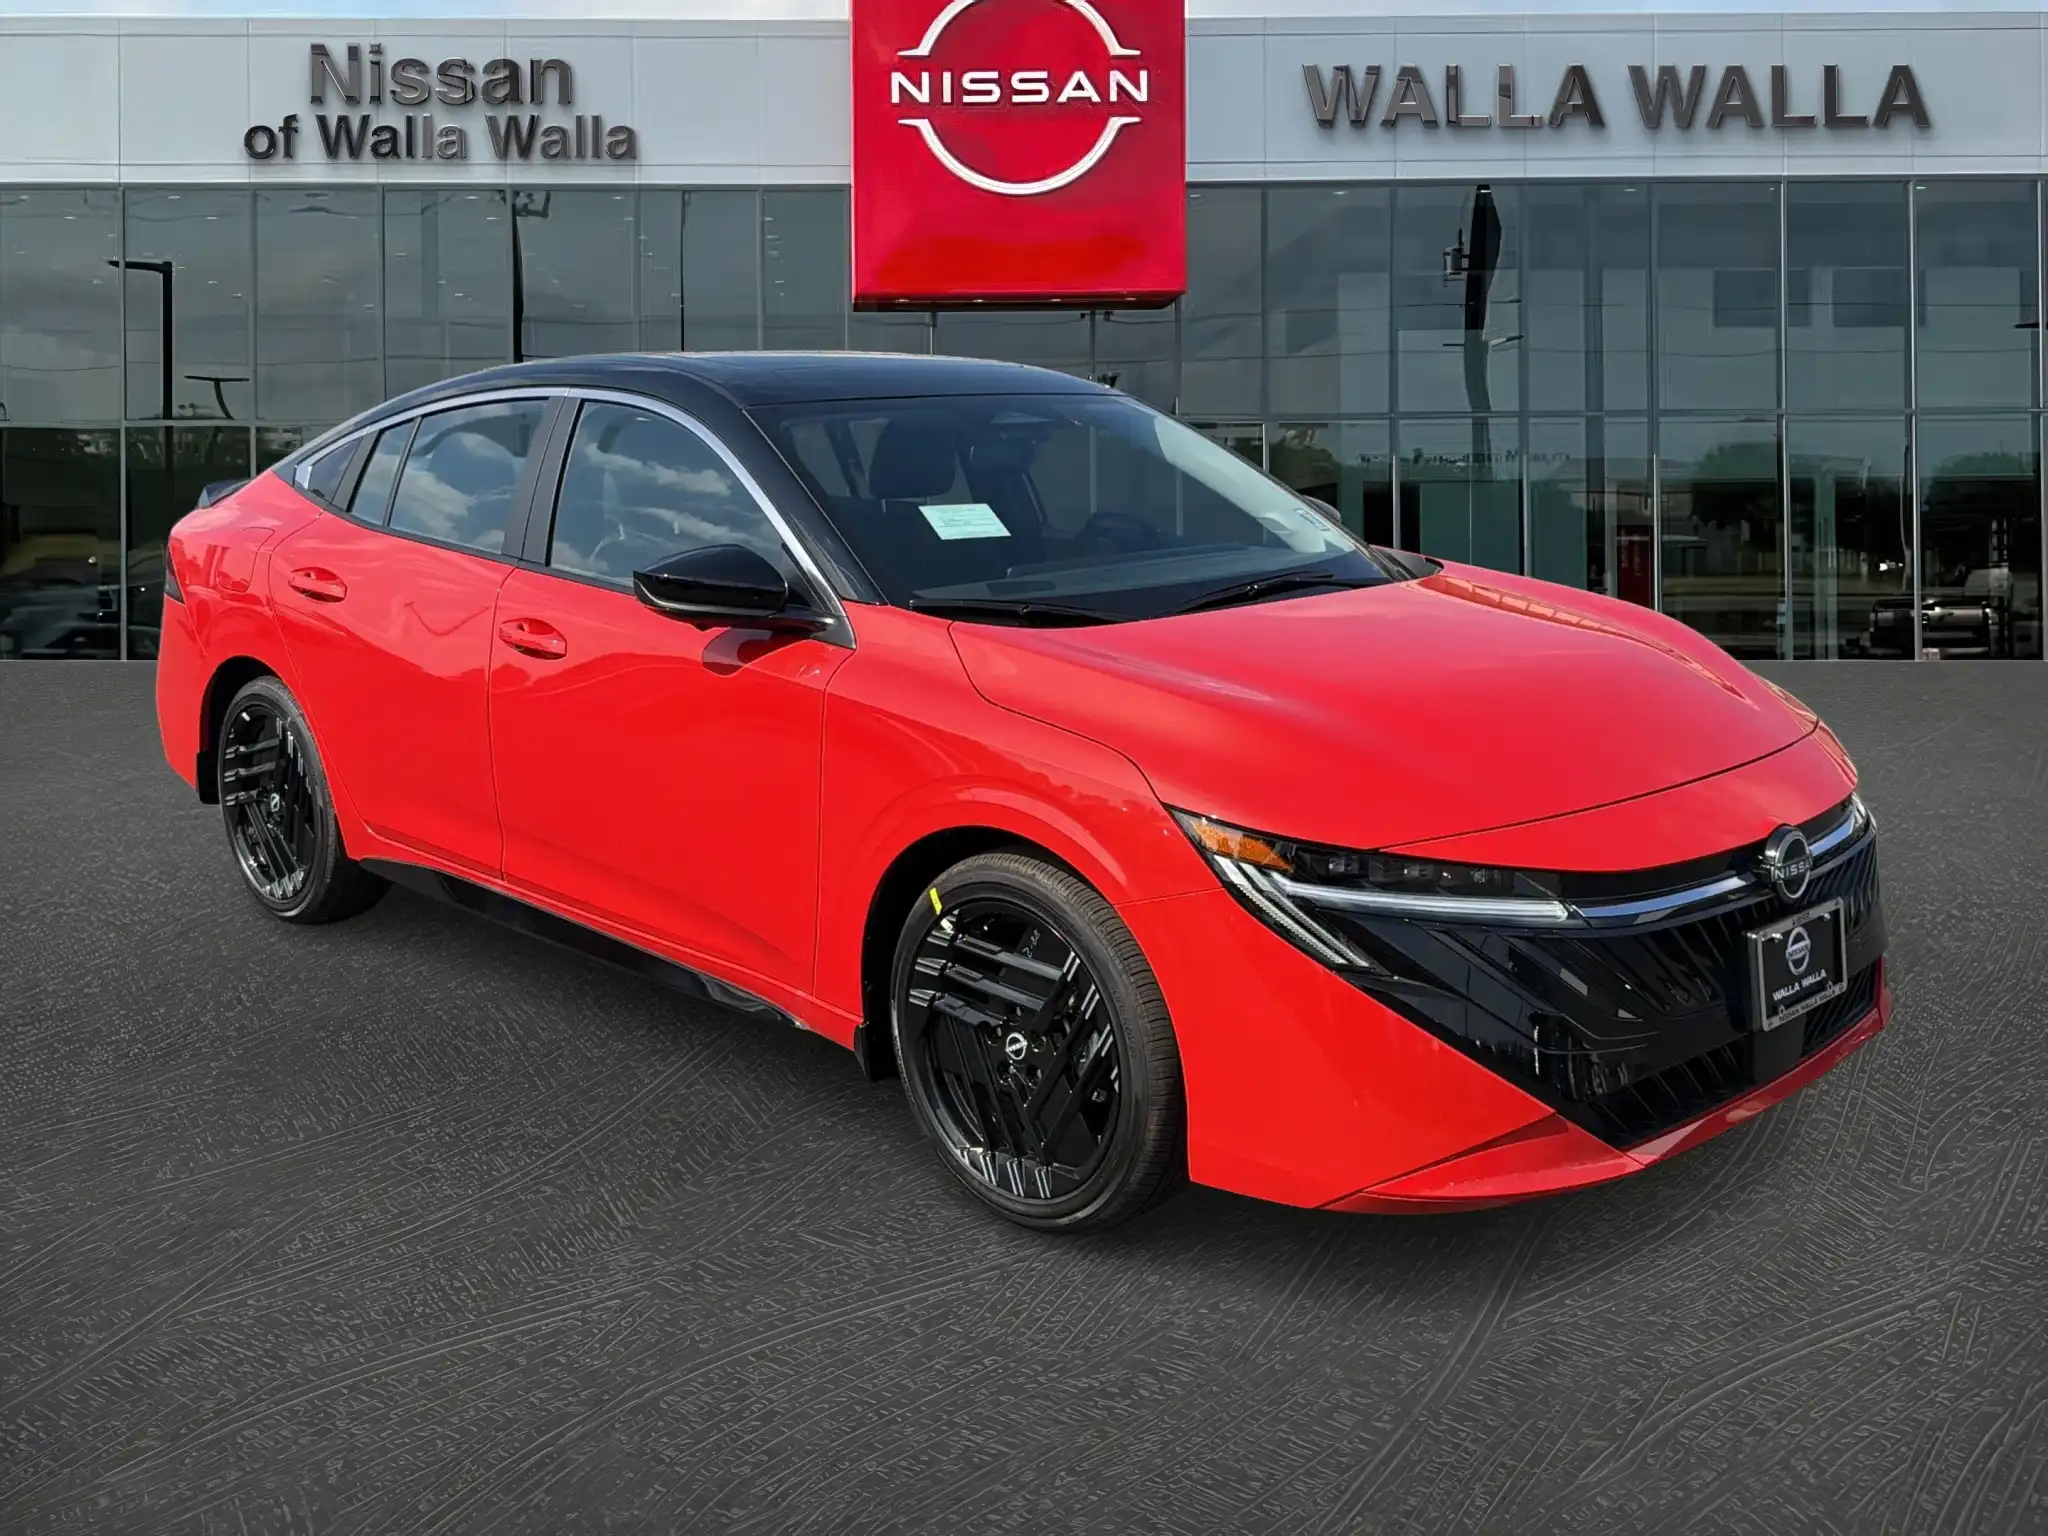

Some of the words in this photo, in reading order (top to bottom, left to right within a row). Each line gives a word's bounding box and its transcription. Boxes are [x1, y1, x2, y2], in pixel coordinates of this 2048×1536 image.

[310, 42, 573, 105] Nissan
[890, 69, 1149, 104] NISSAN
[1301, 63, 1605, 129] WALLA
[1627, 63, 1931, 129] WALLA
[243, 113, 299, 160] of
[315, 113, 468, 160] Walla
[484, 113, 637, 160] Walla
[1772, 981, 1801, 1001] WALLA
[1801, 968, 1827, 988] WALLA
